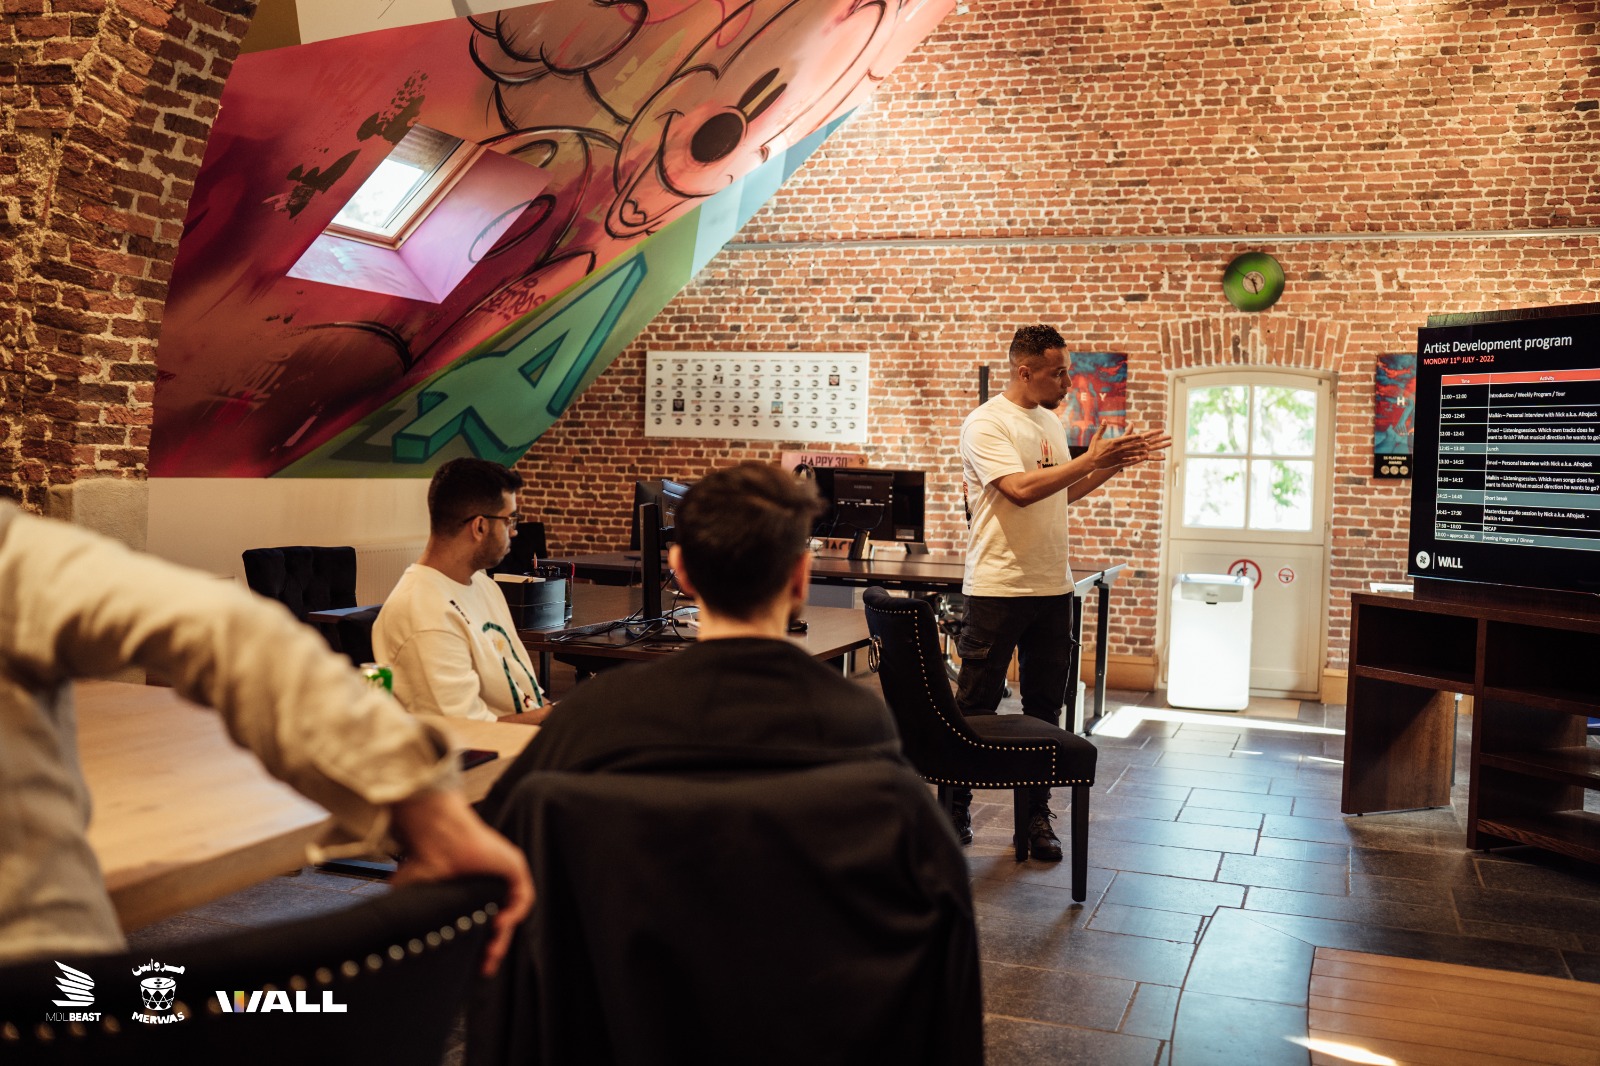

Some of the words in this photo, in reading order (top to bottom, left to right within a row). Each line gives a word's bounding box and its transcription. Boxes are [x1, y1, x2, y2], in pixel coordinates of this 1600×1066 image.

[1423, 342, 1451, 354] Artist
[1452, 339, 1522, 353] Development
[1524, 336, 1573, 351] program
[1423, 357, 1449, 366] MONDAY
[1461, 356, 1475, 364] JULY
[1479, 355, 1495, 363] 2022
[800, 455, 833, 466] HAPPY
[1437, 555, 1463, 569] WALL
